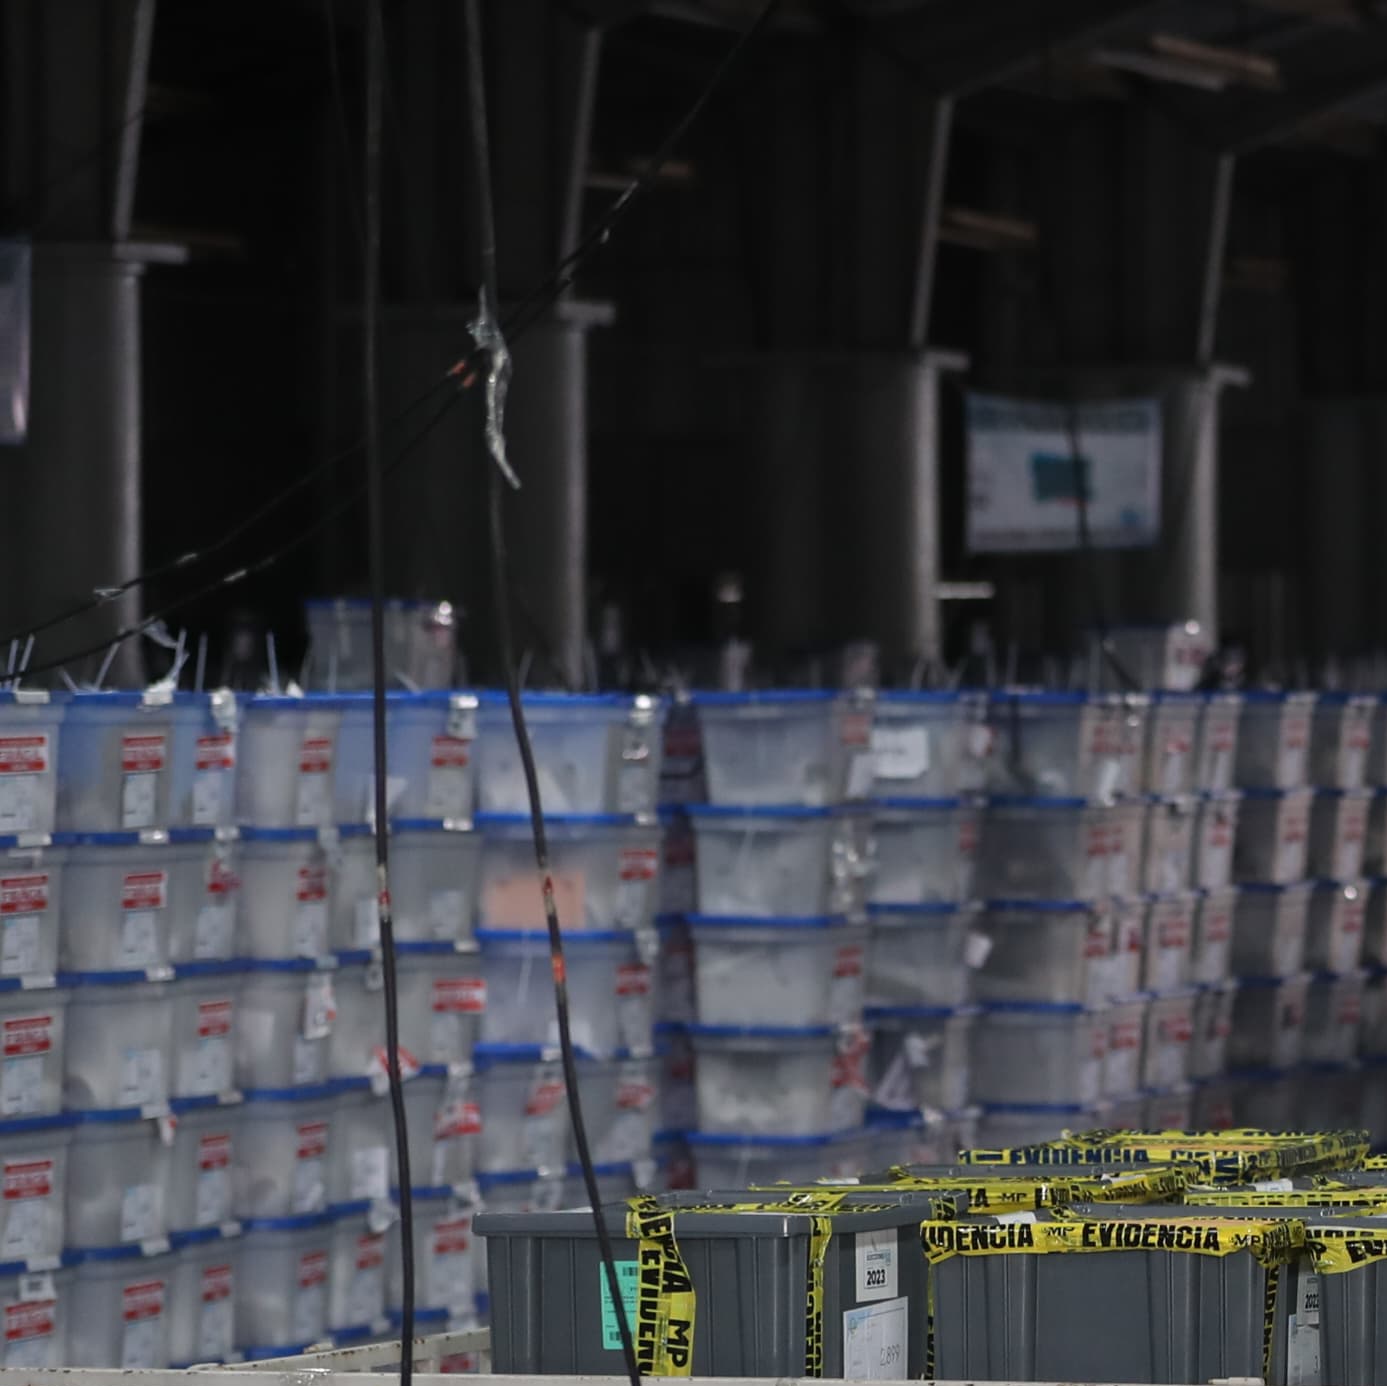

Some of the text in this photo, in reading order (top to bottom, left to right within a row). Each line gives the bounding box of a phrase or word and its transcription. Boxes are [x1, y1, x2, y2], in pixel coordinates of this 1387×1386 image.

[1082, 1222, 1220, 1251] EVIDENCIA
[866, 1269, 886, 1287] 2023
[639, 1250, 662, 1376] EVIDENC
[667, 1319, 692, 1368] MP
